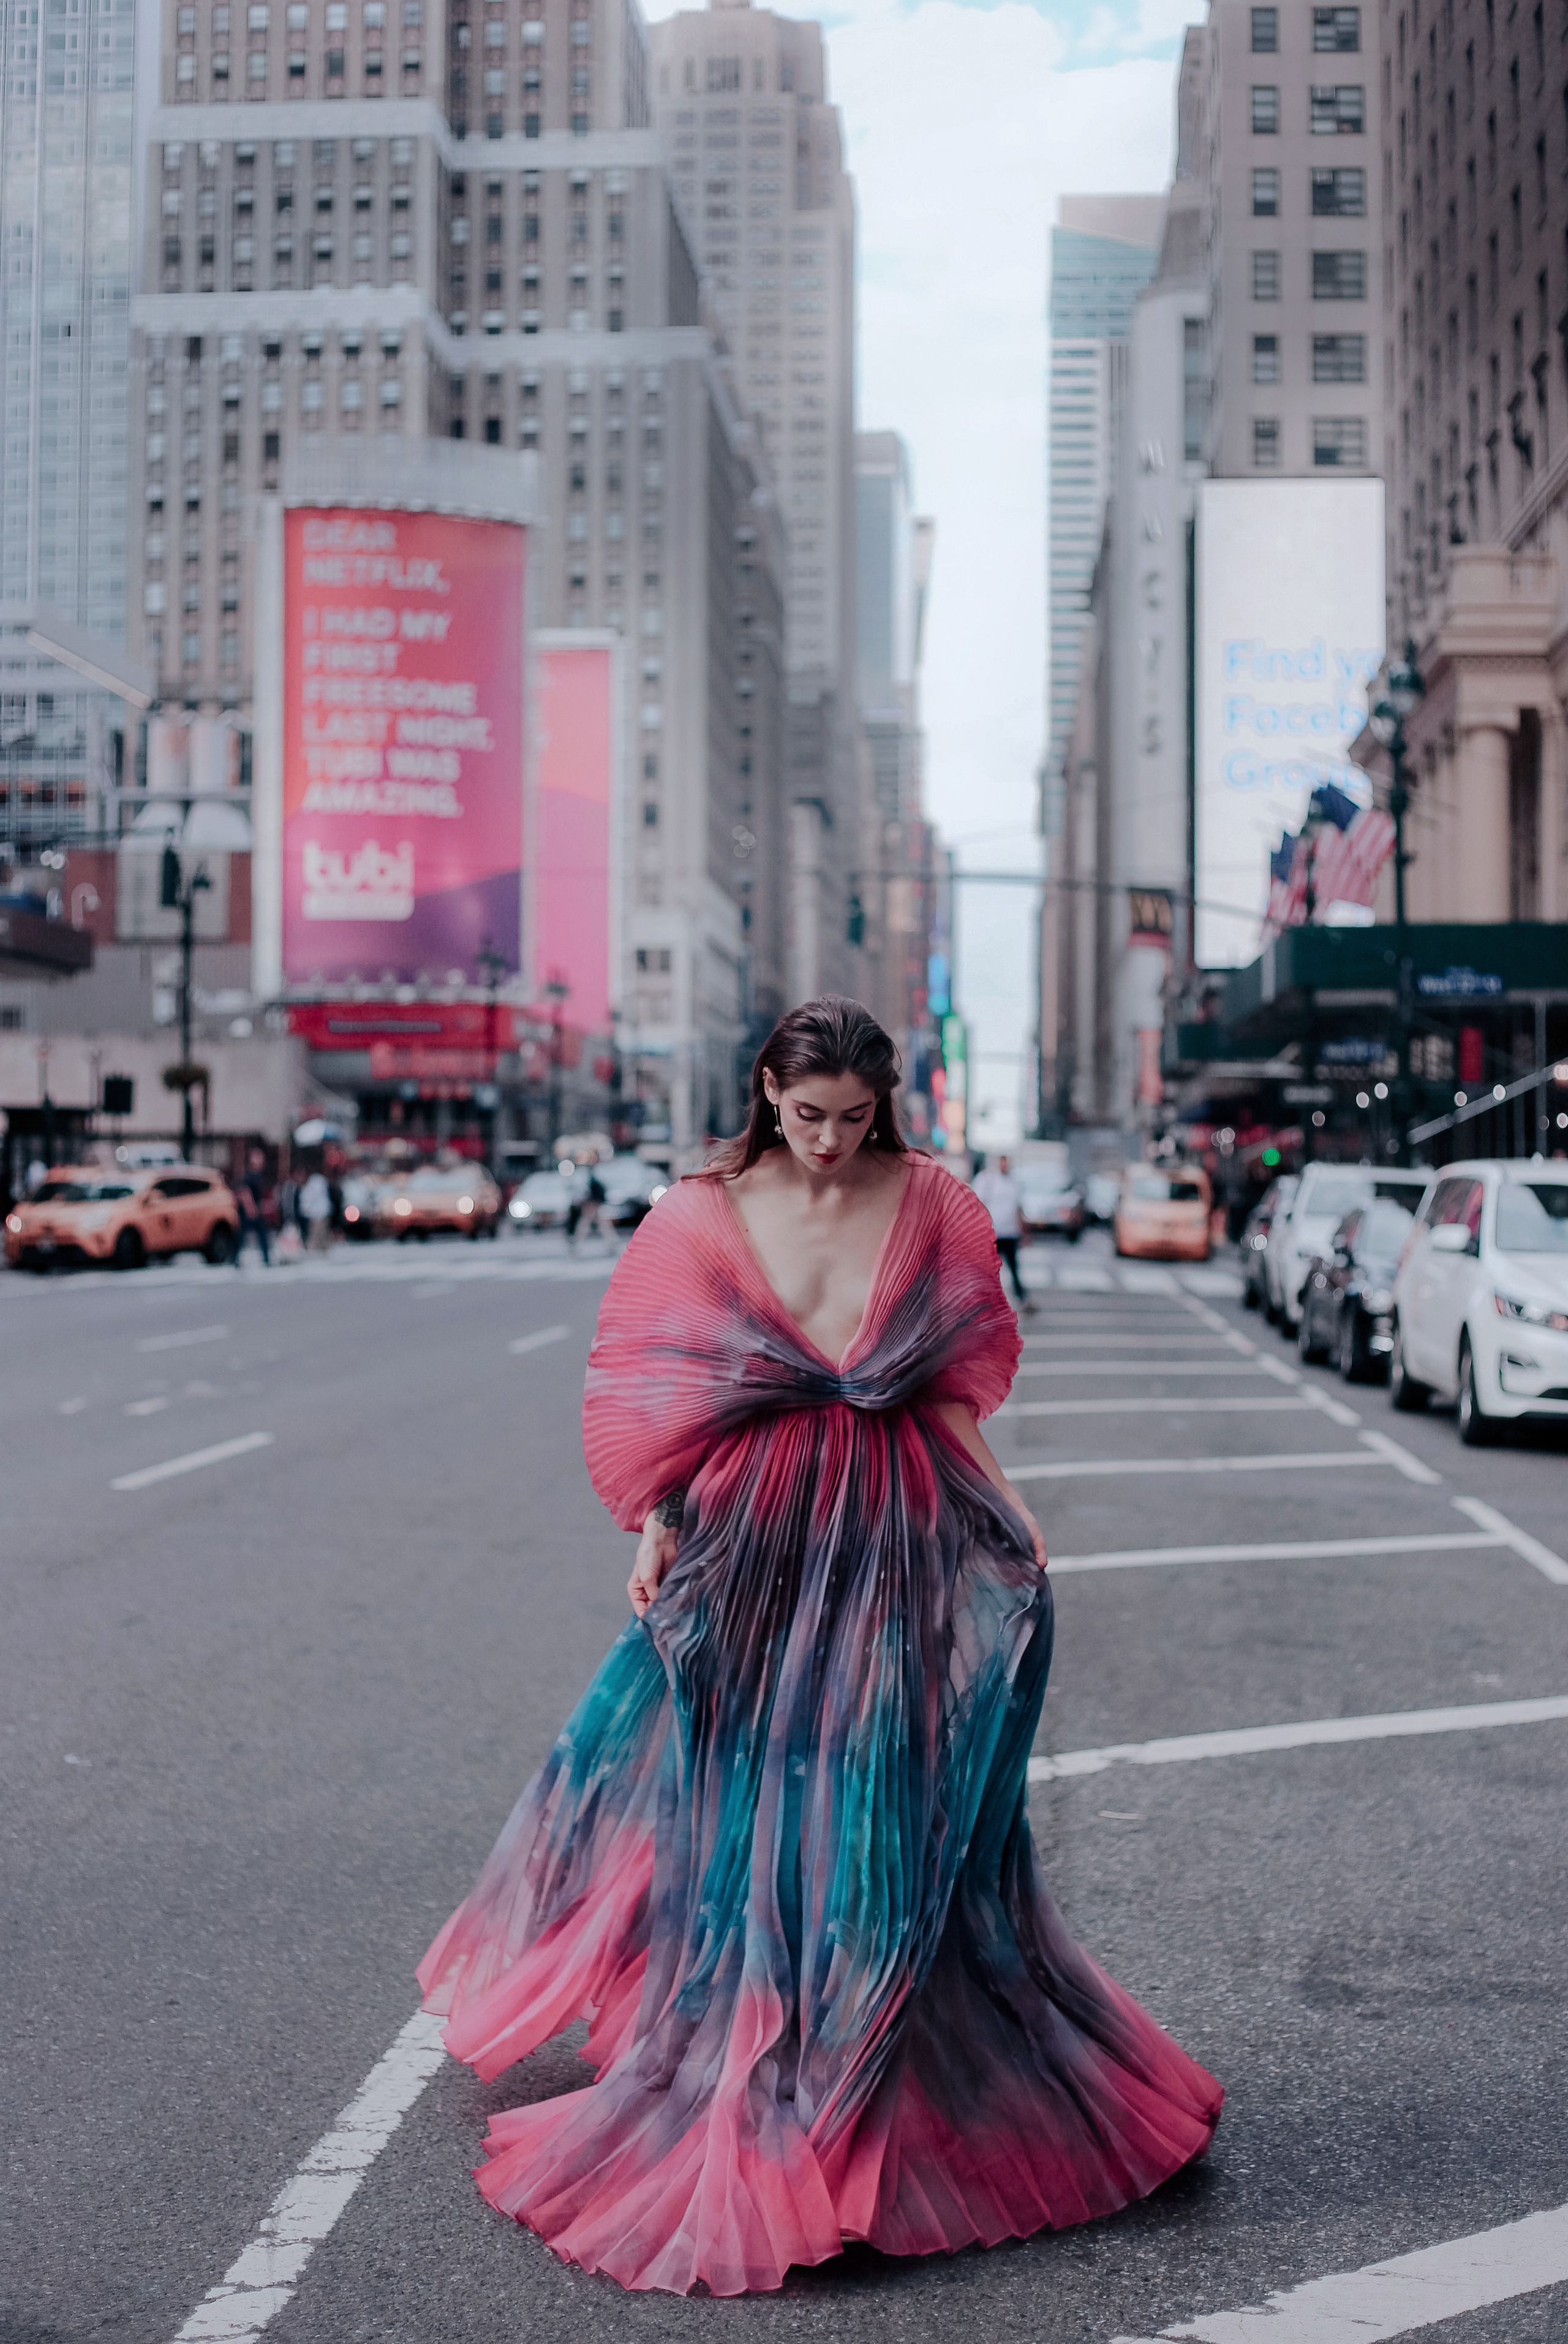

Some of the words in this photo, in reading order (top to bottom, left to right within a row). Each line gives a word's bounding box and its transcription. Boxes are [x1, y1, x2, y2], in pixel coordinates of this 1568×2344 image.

[303, 520, 396, 551] DEAR
[303, 555, 451, 596] NETFLIX,
[304, 607, 318, 638] I
[322, 607, 395, 640] HAD
[399, 608, 453, 643] MY
[303, 643, 401, 675] FIRST
[1226, 637, 1324, 680] Find
[1335, 648, 1384, 691] yo
[303, 712, 390, 743] LAST
[1226, 695, 1368, 734] Faceb
[301, 746, 383, 778] TUBI
[386, 748, 460, 783] WAS
[301, 781, 464, 817] AMAZING.
[303, 839, 415, 892] tubi
